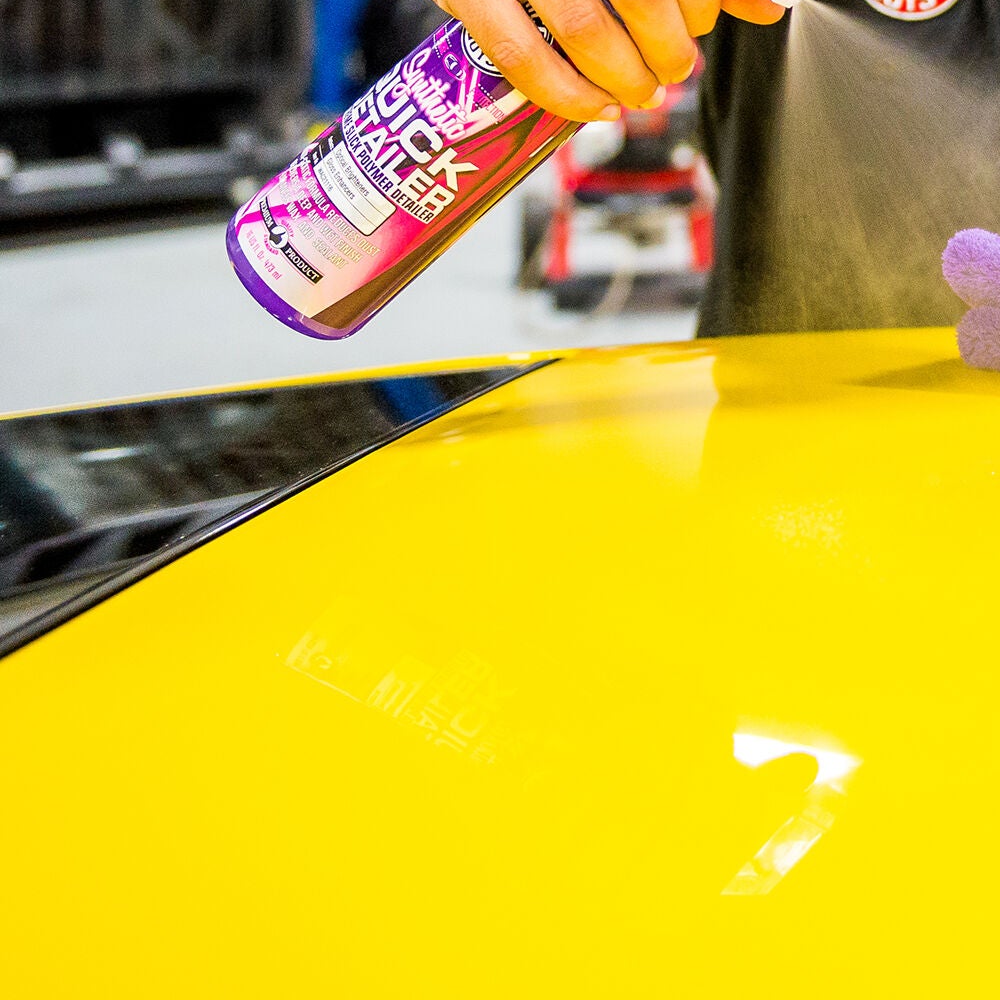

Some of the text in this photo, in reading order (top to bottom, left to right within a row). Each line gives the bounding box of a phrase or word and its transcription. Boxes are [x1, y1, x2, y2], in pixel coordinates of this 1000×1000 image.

[375, 60, 480, 192] QUICK
[391, 47, 467, 140] Synthetic
[333, 172, 356, 200] Enhancers
[344, 165, 371, 197] Brighteners
[346, 125, 361, 153] SLICK
[356, 149, 394, 193] POLYMER
[390, 188, 435, 223] DETAILER
[285, 202, 302, 221] WAX
[298, 221, 315, 240] AND
[311, 237, 349, 270] SEALANT
[297, 189, 313, 211] DEEP
[306, 208, 324, 227] AND
[320, 223, 339, 243] WET
[334, 238, 363, 264] FINISH
[304, 176, 331, 213] FORMULA
[325, 209, 360, 244] REDUCES
[356, 237, 381, 257] DUST
[263, 259, 276, 273] 473
[284, 247, 320, 281] PRODUCT
